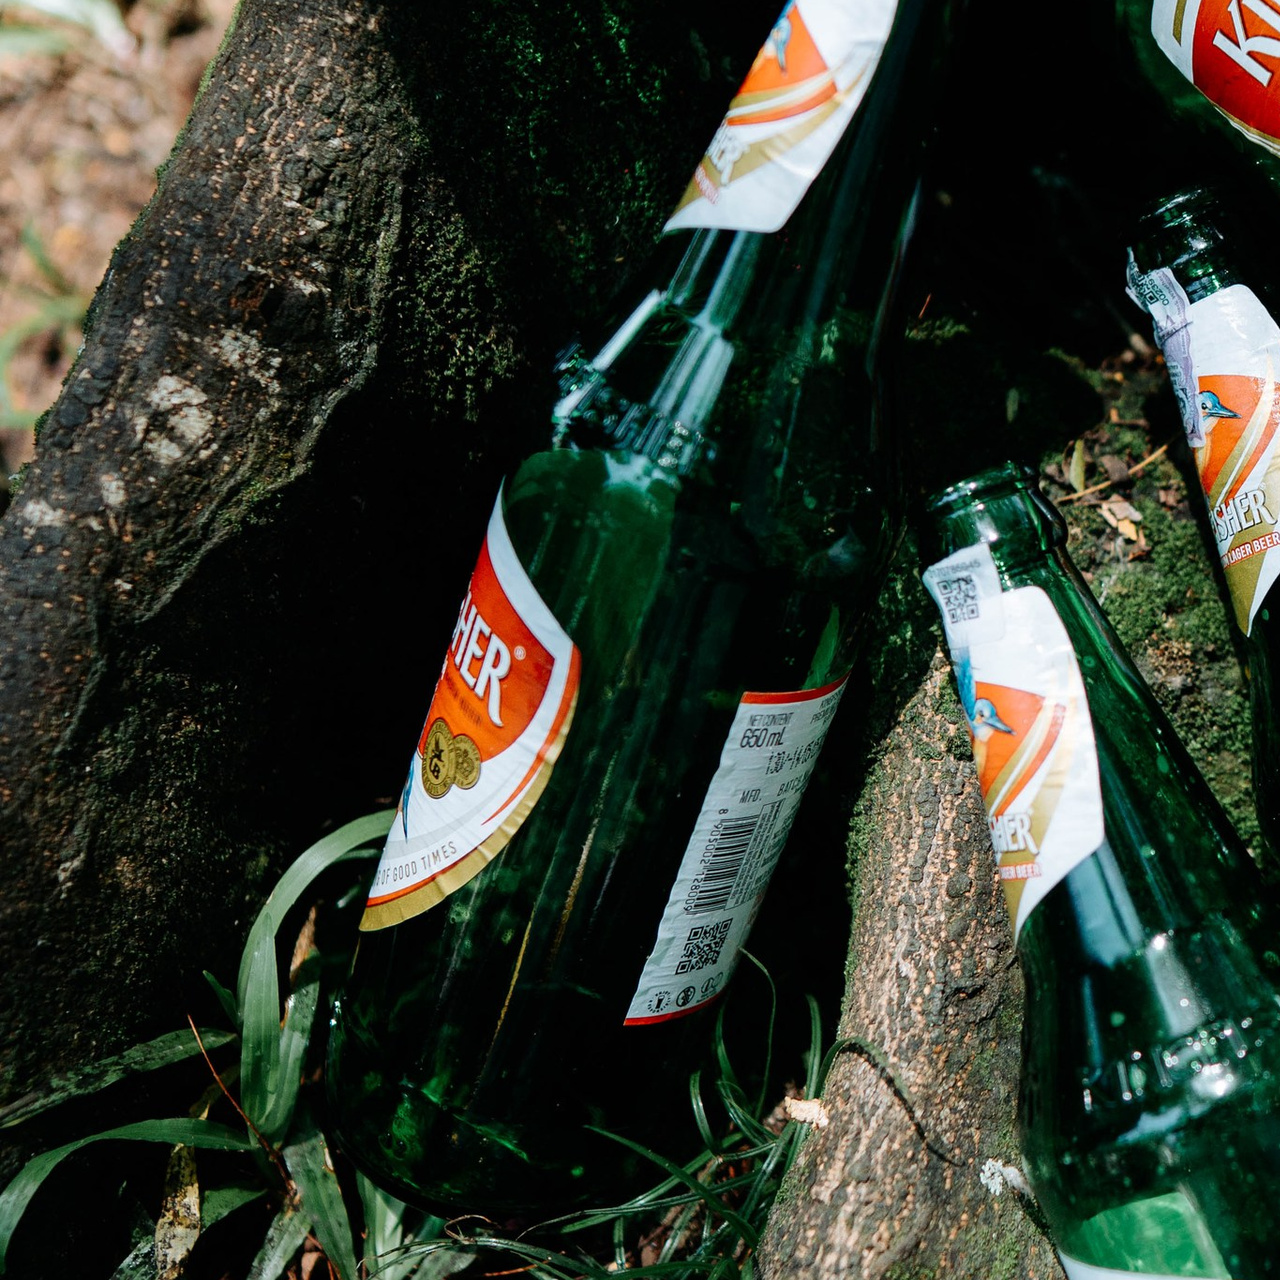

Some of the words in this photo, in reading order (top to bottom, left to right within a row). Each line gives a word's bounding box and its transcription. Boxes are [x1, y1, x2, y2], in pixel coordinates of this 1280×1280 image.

[1229, 542, 1253, 564] LAGER
[740, 728, 768, 748] 650
[766, 726, 786, 747] mL
[700, 823, 724, 866] 905002
[392, 860, 418, 883] GOOD
[421, 841, 458, 871] TIMES
